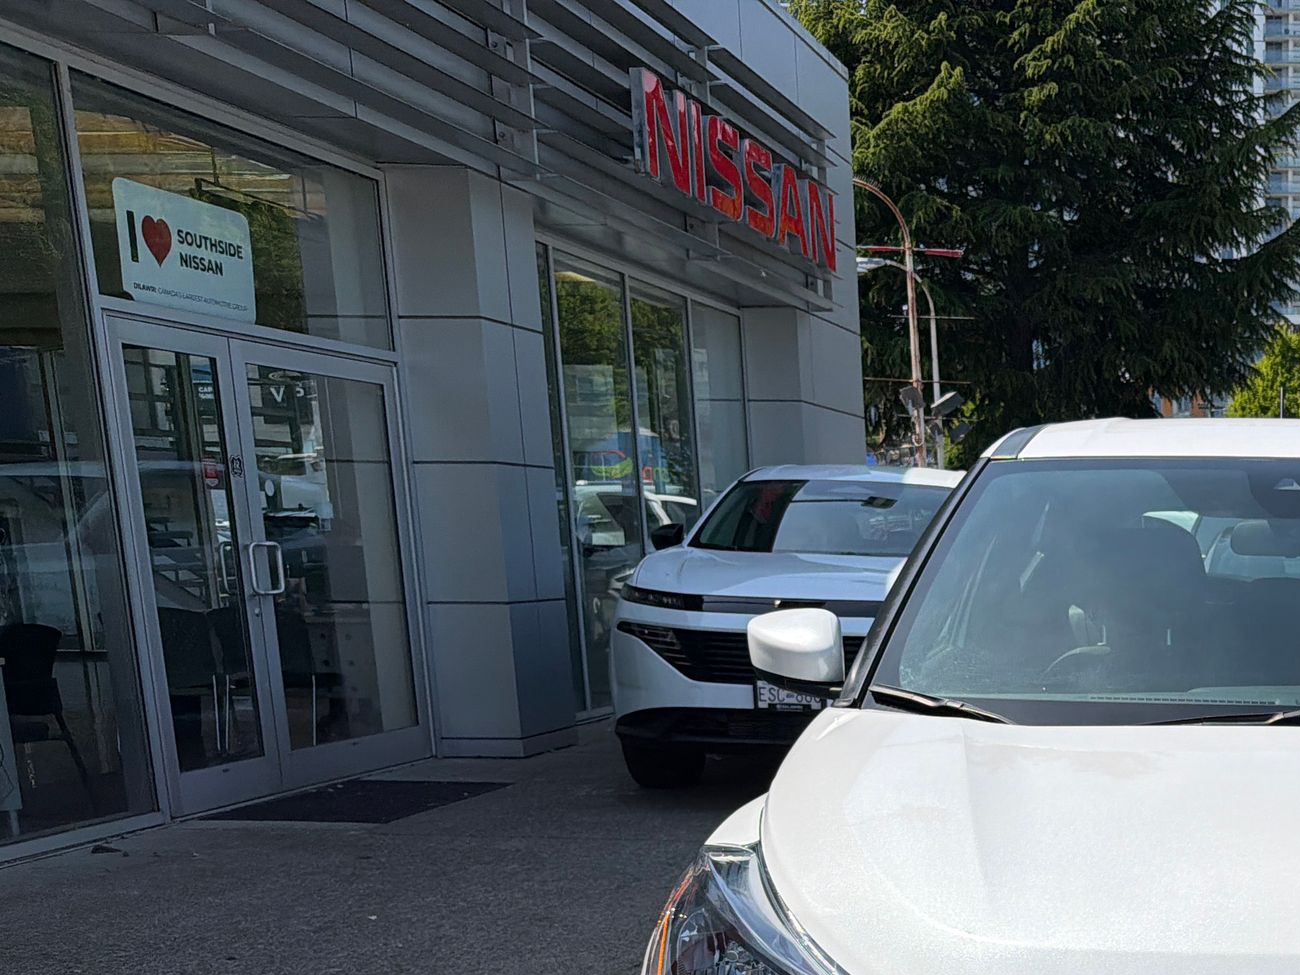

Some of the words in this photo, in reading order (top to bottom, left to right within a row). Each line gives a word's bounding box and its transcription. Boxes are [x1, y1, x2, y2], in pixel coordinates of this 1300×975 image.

[630, 67, 837, 273] NISSAN
[126, 210, 139, 263] I
[176, 229, 244, 260] SOUTHSIDE
[179, 252, 224, 276] NISSAN
